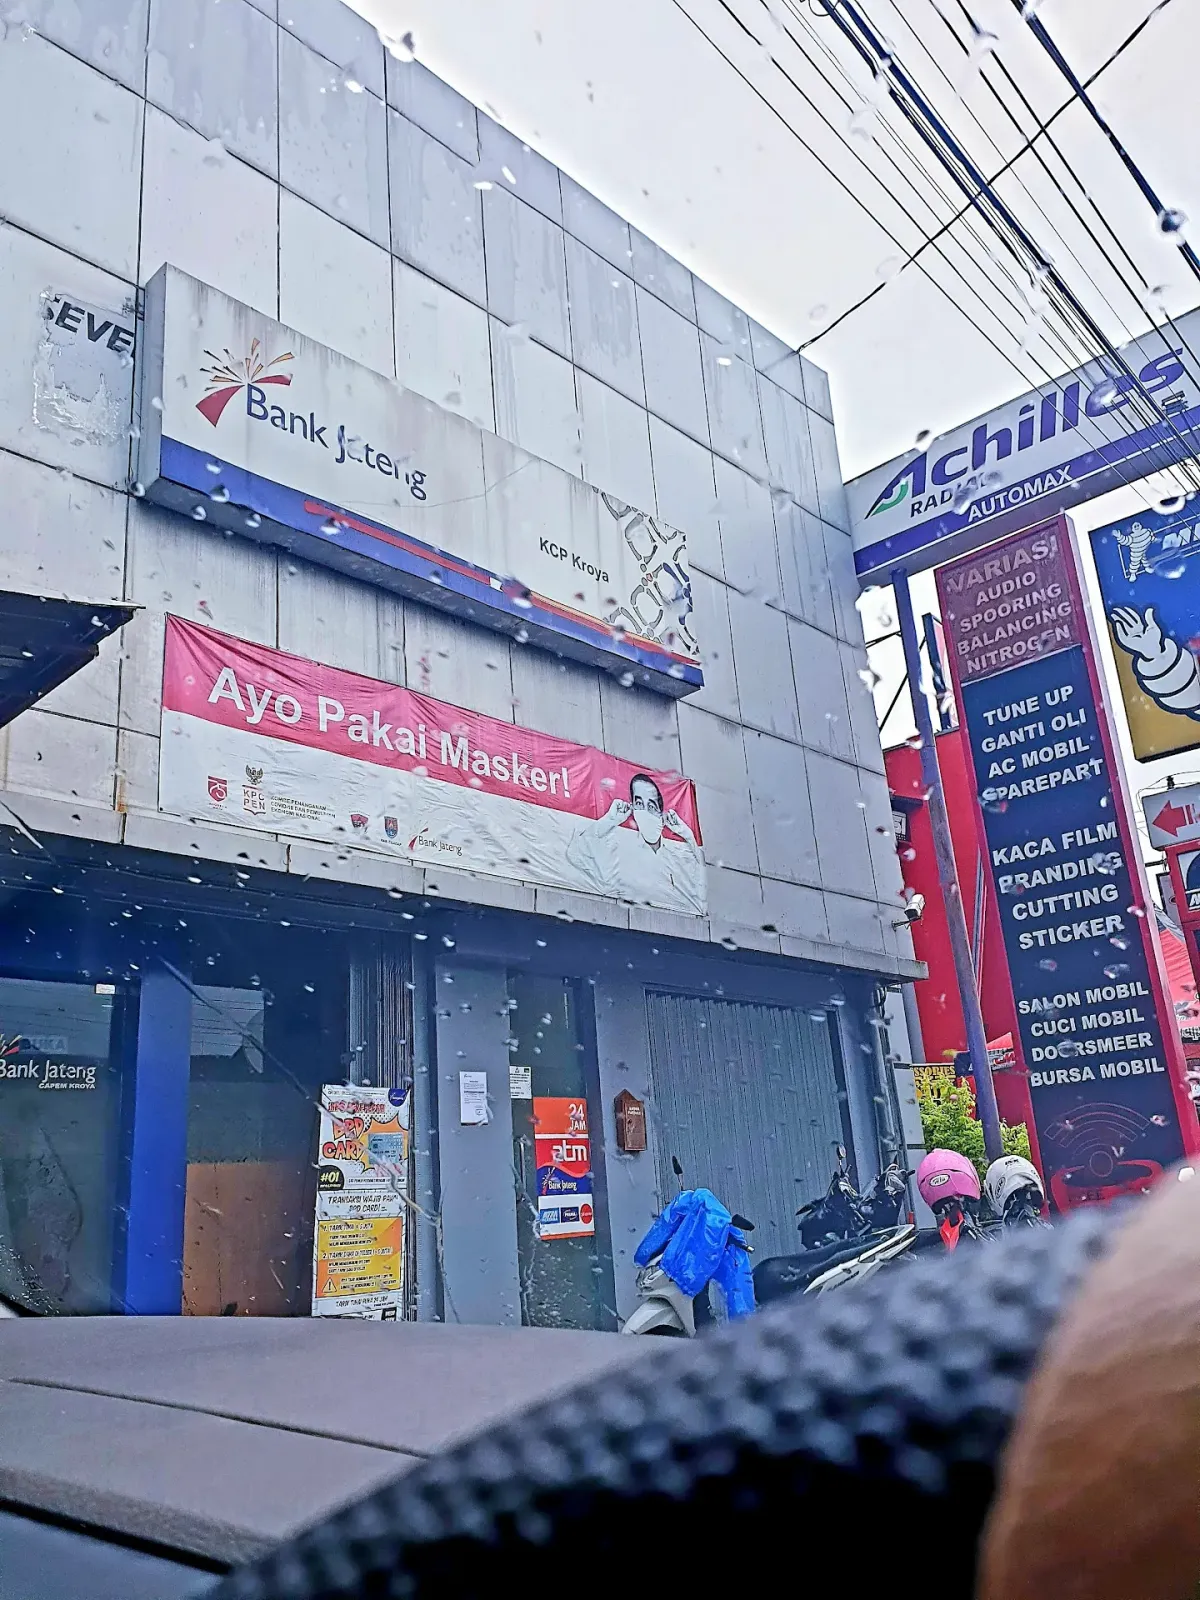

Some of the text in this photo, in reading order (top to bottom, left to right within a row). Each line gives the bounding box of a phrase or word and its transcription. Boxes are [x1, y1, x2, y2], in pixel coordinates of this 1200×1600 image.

[246, 382, 330, 449] Bank
[865, 348, 1183, 519] Achilles
[967, 465, 1074, 522] AUTOMAX
[539, 537, 610, 583] KCP Kroya
[947, 534, 1059, 594] VARIASI
[960, 582, 1062, 633] SPOORING
[975, 571, 1037, 606] AUDIO
[957, 601, 1073, 656] BALANCING
[967, 624, 1071, 674] NITROGEN
[983, 685, 1074, 727] TUNE UP
[208, 667, 572, 798] Ayo Pakai Masker!
[981, 708, 1087, 754] GANTI OLI
[988, 736, 1090, 779] AC MOBIL
[243, 789, 265, 801] KPC
[981, 759, 1104, 802] SPAREPART
[243, 799, 266, 810] PEN
[419, 835, 462, 856] Bank Jateng
[993, 821, 1119, 866] KACA FILM
[1012, 883, 1120, 921] CUTTING
[1018, 914, 1125, 950] STICKER
[1018, 981, 1149, 1015] SALON MOBIL
[1030, 1007, 1145, 1038] CUCI MOBIL
[0, 1059, 97, 1084] Bank Jateng
[1030, 1056, 1165, 1087] BURSA MOBIL
[568, 1103, 584, 1120] 24
[570, 1120, 586, 1131] JAM
[552, 1139, 588, 1163] atm
[320, 1171, 340, 1183] #01
